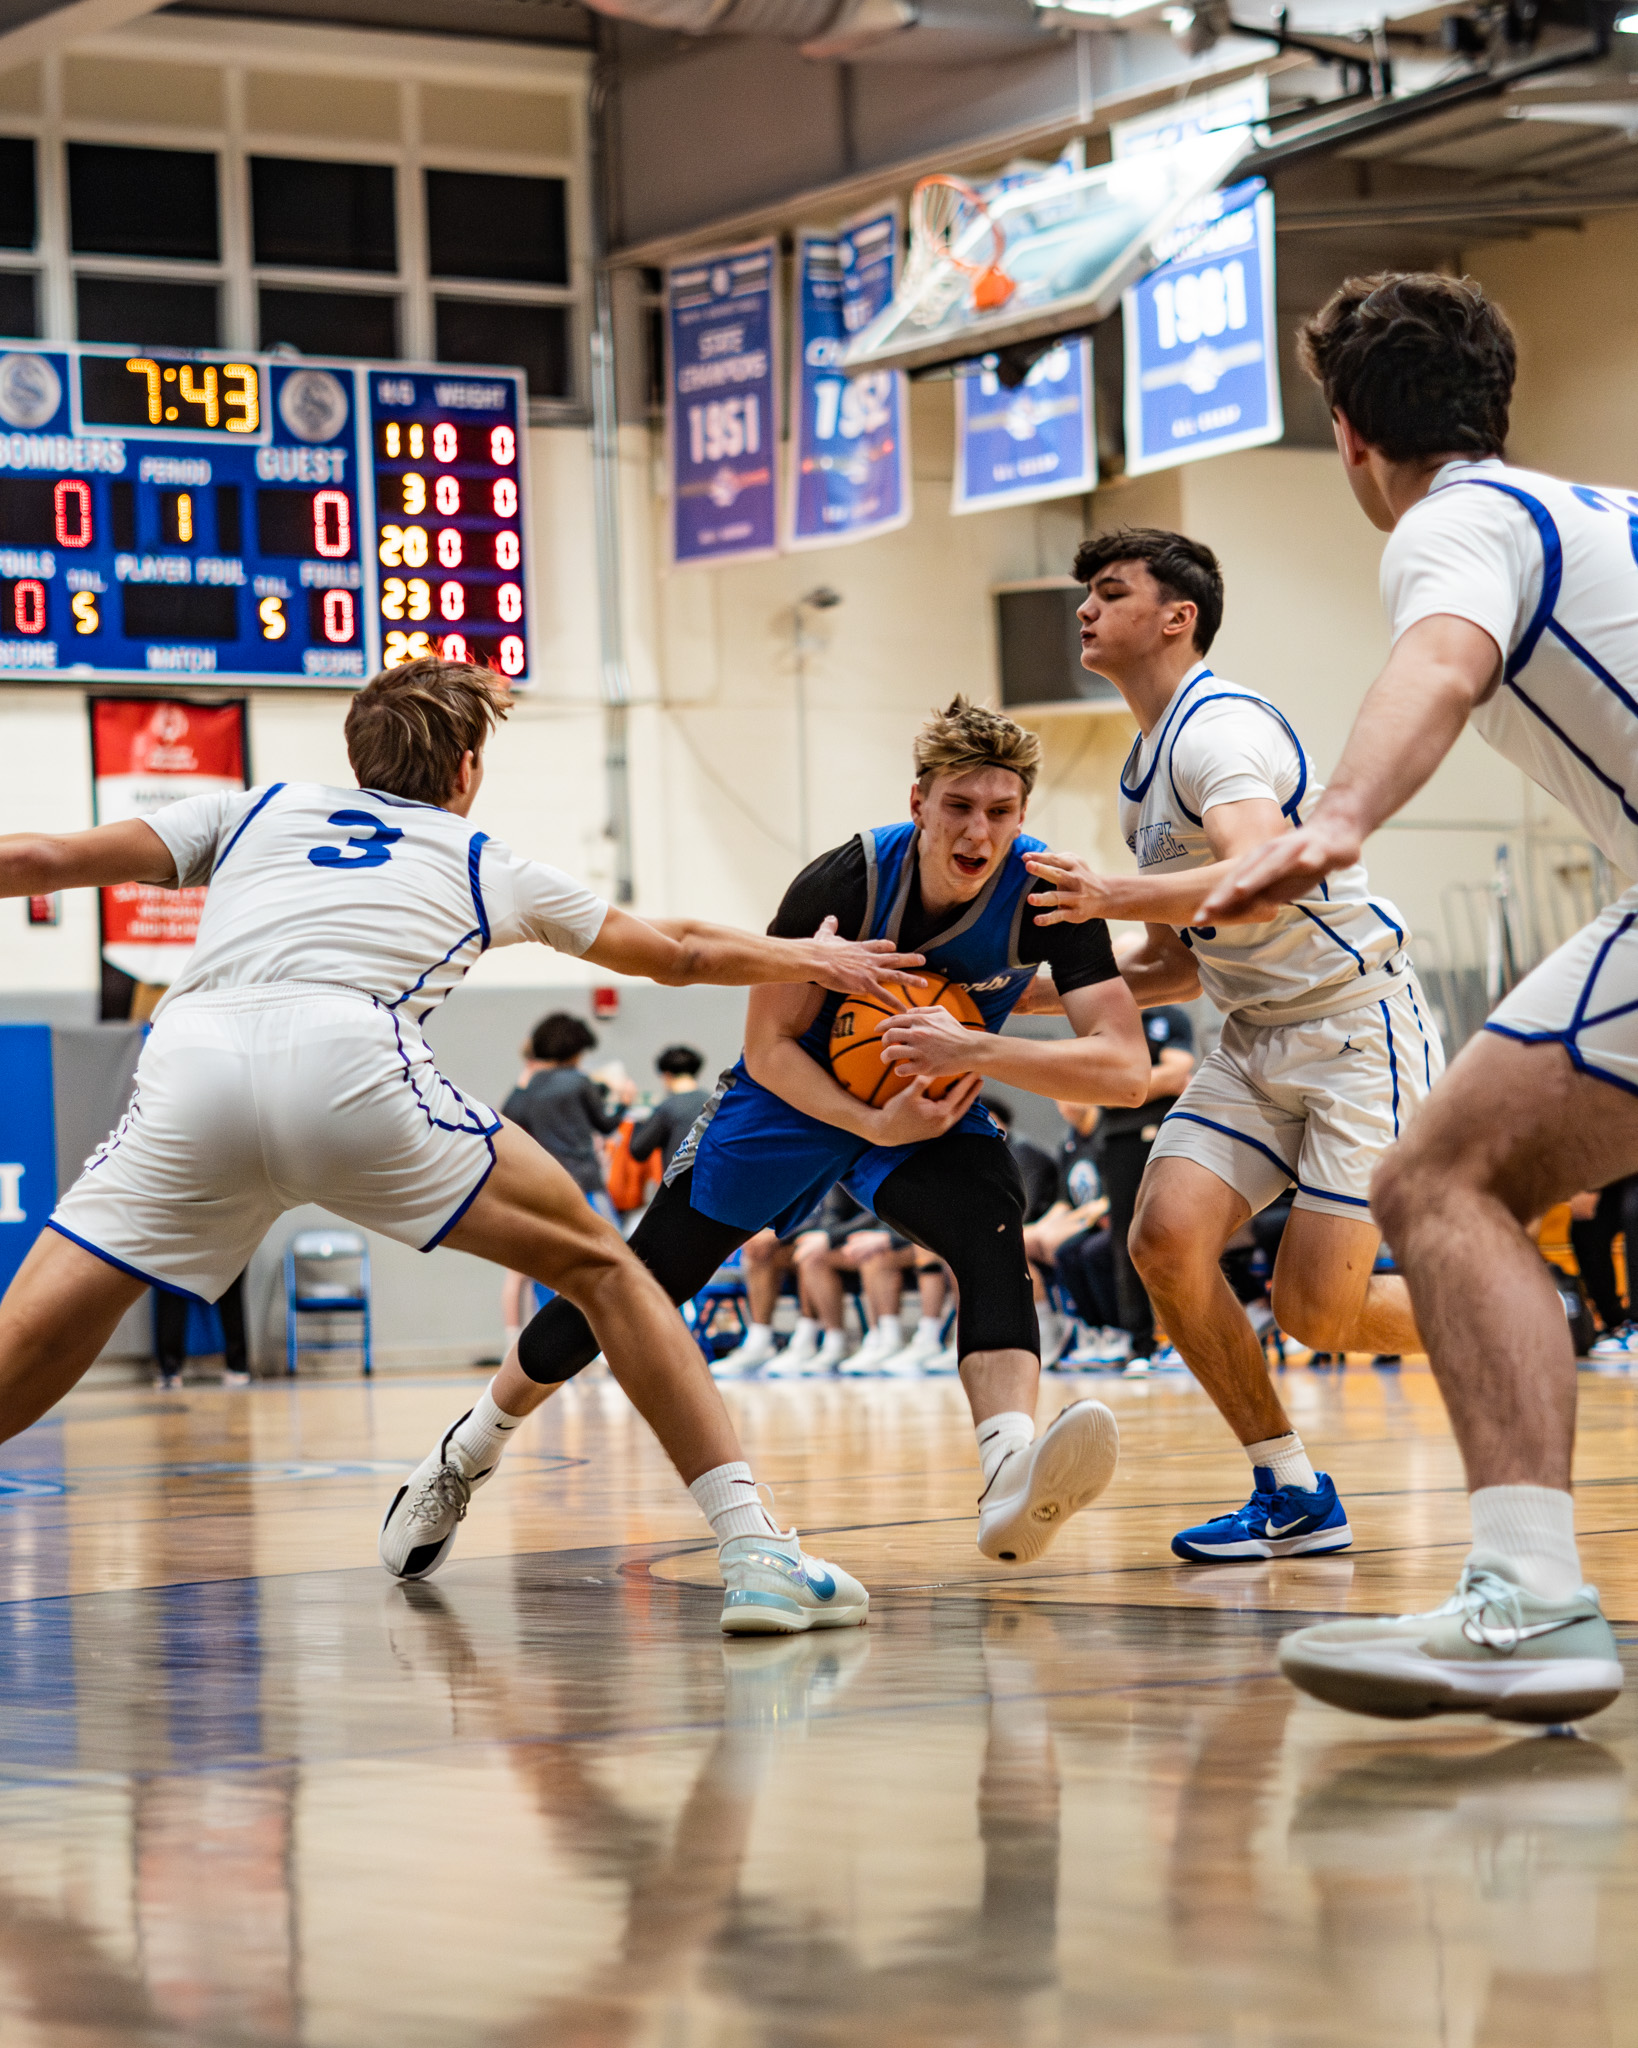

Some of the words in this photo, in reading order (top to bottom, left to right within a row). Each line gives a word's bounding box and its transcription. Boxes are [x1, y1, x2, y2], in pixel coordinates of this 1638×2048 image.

[126, 358, 259, 432] 7:43
[386, 422, 425, 460] 11
[433, 422, 458, 463] 0
[490, 425, 516, 466] 0
[688, 393, 760, 465] 1951
[256, 446, 348, 484] GUEST
[54, 479, 92, 548] 0
[177, 493, 193, 542] 1
[402, 472, 426, 515] 3
[435, 475, 460, 516] 0
[493, 477, 518, 518] 0
[313, 490, 351, 557] 0
[379, 524, 428, 568] 20
[438, 528, 463, 568] 0
[495, 530, 520, 570] 0
[115, 553, 192, 583] PLAYER
[195, 557, 248, 586] FOUL
[300, 560, 361, 590] FOULS
[14, 579, 46, 634] 0
[324, 589, 354, 643] 0
[381, 577, 431, 621] 23
[440, 580, 465, 621] 0
[498, 582, 522, 623] 0
[500, 635, 524, 675] 0
[307, 809, 405, 869] 3
